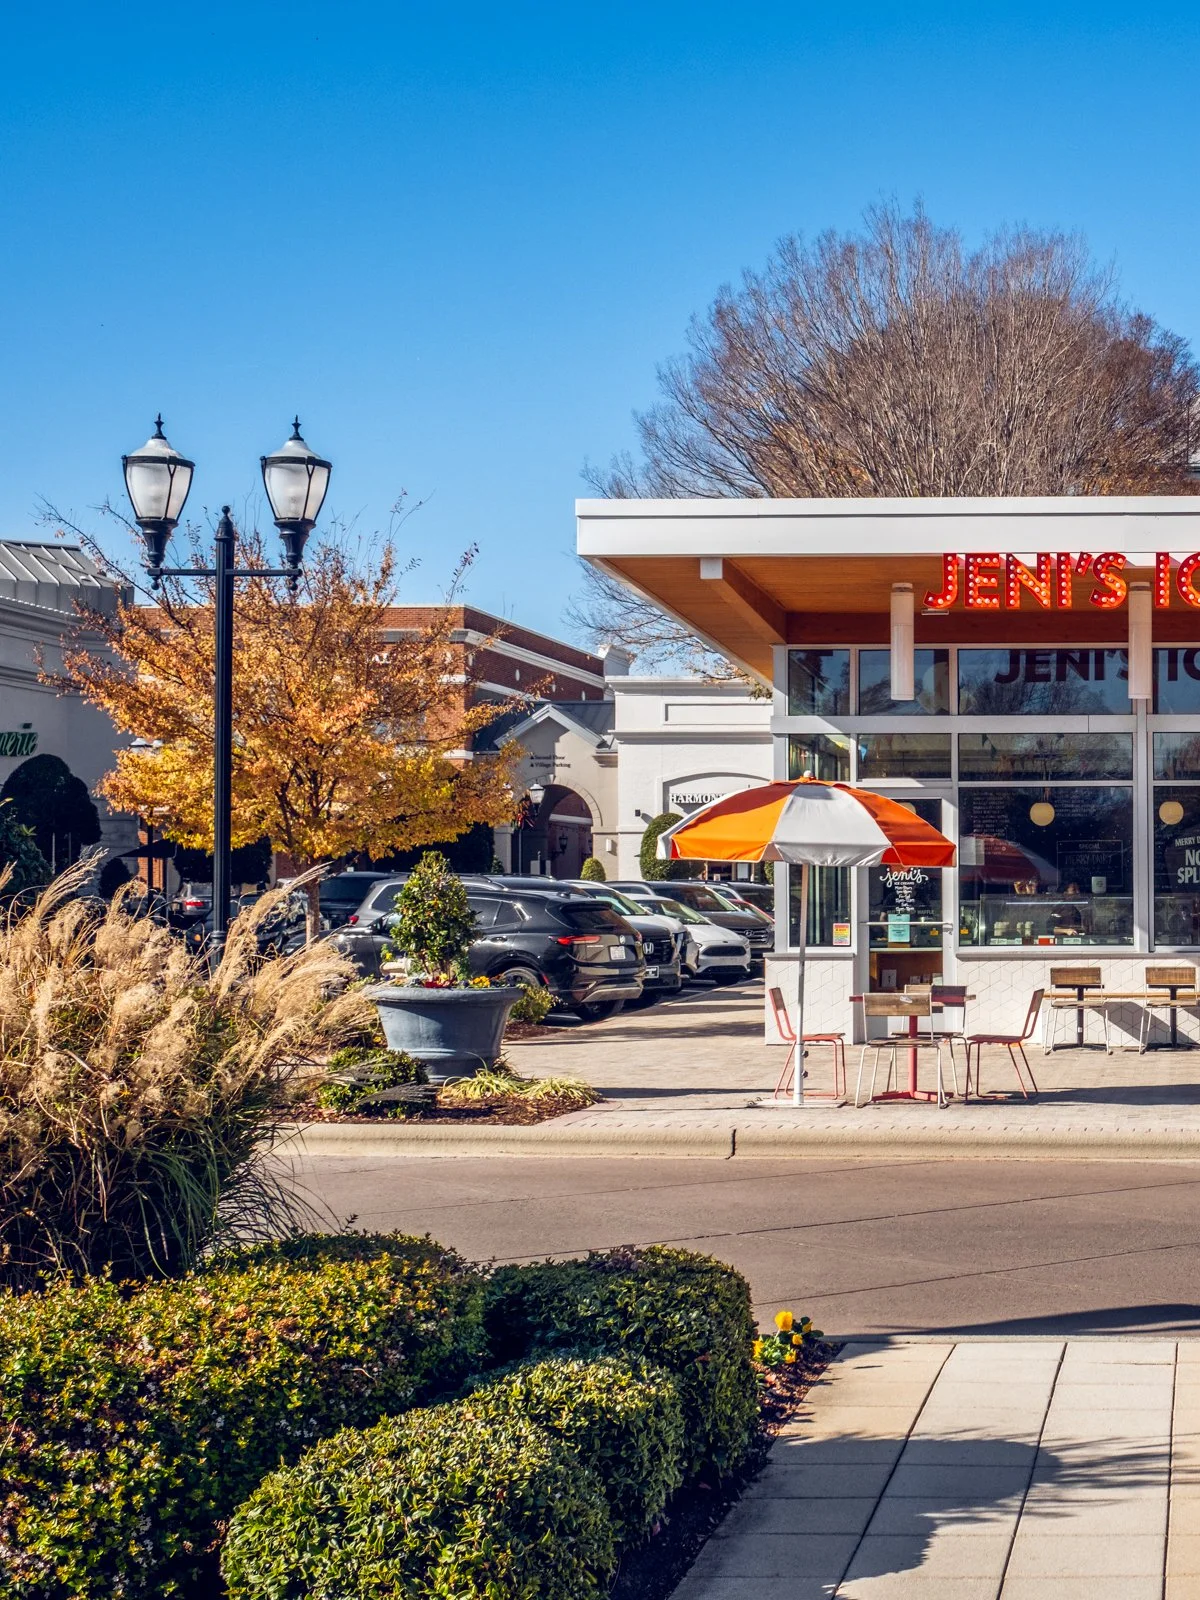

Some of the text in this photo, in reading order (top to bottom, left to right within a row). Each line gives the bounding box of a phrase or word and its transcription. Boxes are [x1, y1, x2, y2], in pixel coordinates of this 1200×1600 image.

[923, 551, 1128, 609] JENI'S
[1175, 837, 1196, 847] MERRY
[880, 868, 929, 888] jeni's
